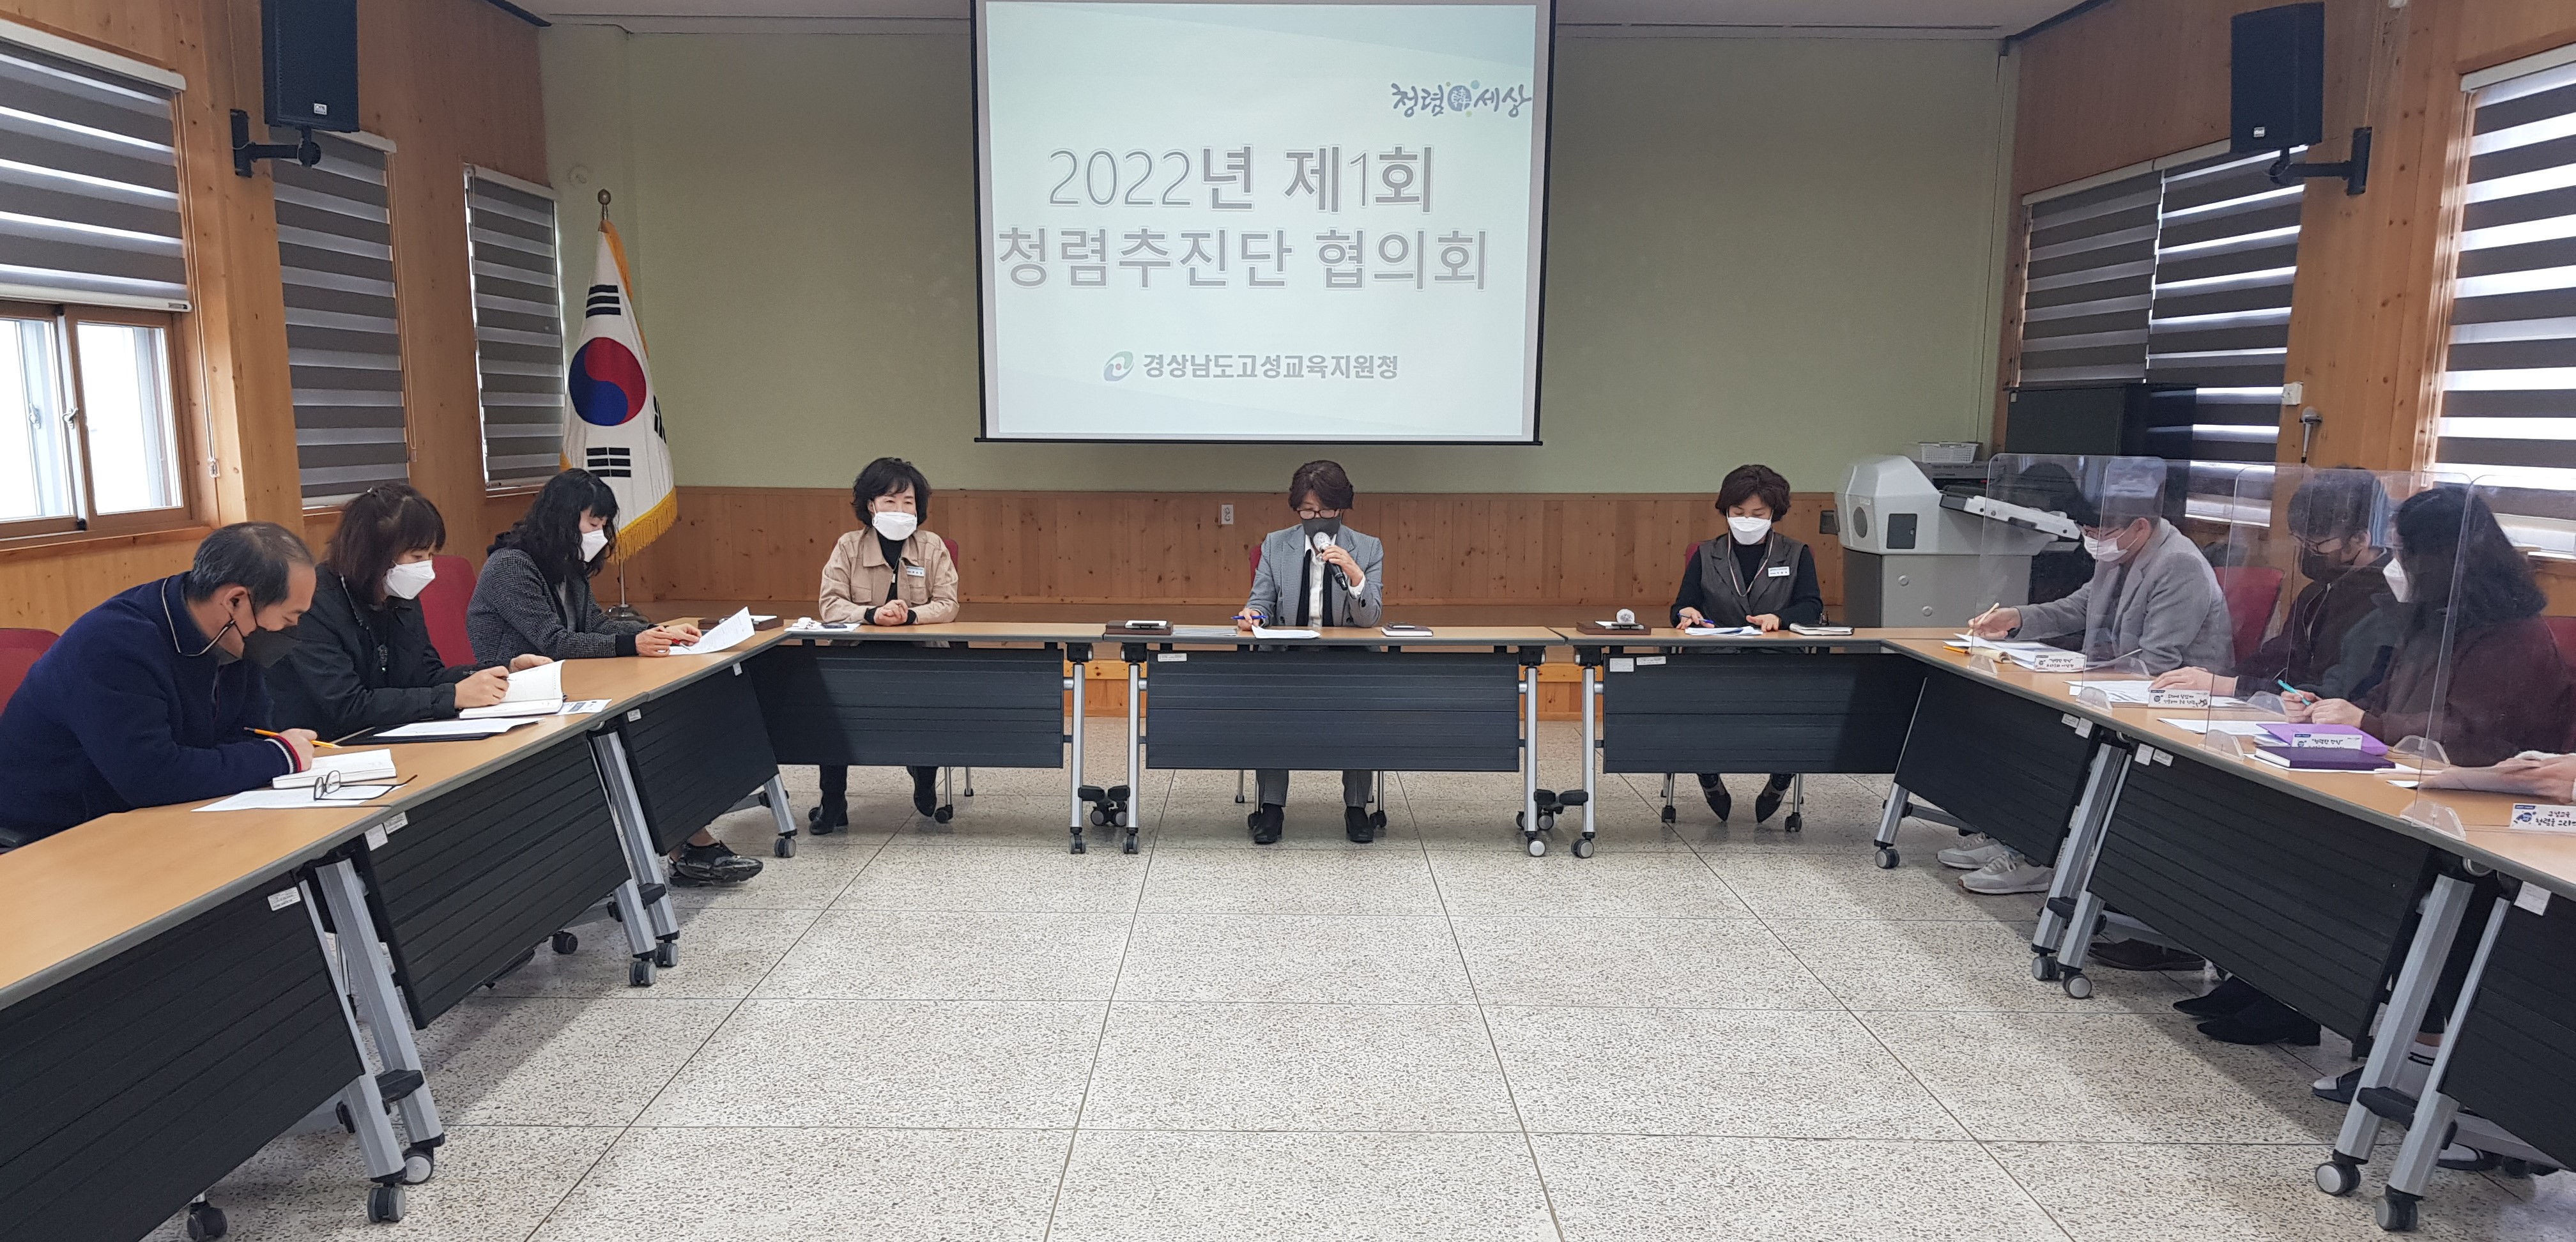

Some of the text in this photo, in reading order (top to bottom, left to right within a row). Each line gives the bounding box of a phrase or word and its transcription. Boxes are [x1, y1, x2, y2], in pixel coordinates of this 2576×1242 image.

[1391, 82, 1445, 118] 청렴
[1473, 84, 1532, 118] 세상
[1048, 146, 1435, 213] 2022년 제1회
[998, 227, 1487, 291] 청렴추진단 협의회
[1142, 353, 1399, 380] 경상남도고성교육지원청
